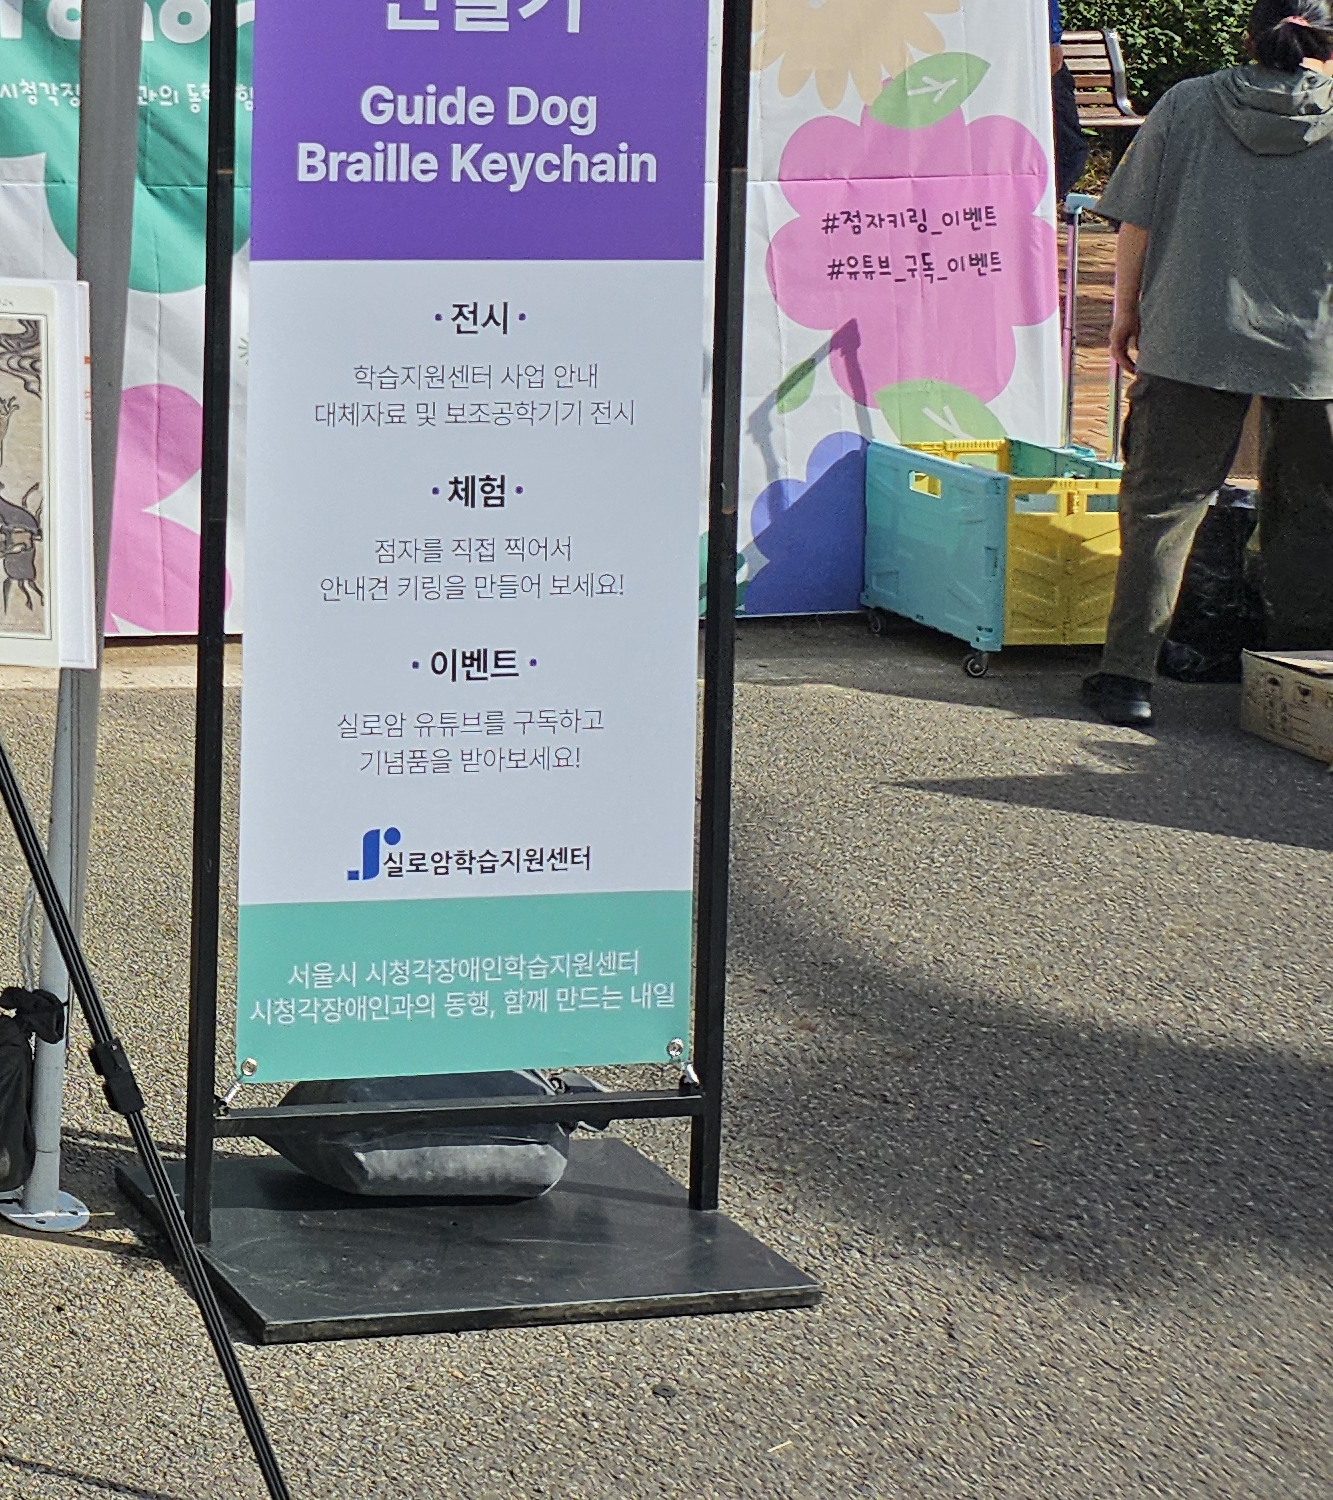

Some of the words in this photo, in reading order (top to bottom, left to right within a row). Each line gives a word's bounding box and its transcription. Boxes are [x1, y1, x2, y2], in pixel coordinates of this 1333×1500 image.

[361, 85, 495, 127] Guide
[507, 87, 598, 135] Dog
[297, 141, 438, 185] Braille
[451, 142, 658, 192] Keychain
[820, 204, 998, 235] #점자키링_이벤트
[826, 250, 1003, 284] #유튜브_구독_이벤트
[450, 301, 509, 335] 전시
[353, 364, 493, 390] 학습지원센터
[500, 364, 546, 389] 사업
[553, 363, 599, 389] 안내
[314, 402, 407, 427] 대체자료
[416, 402, 437, 427] 및
[445, 400, 583, 426] 보조공학기기
[590, 400, 636, 426] 전시
[448, 474, 506, 509] 체험
[374, 537, 444, 564] 점자를
[451, 537, 496, 563] 직접
[504, 536, 573, 562] 찍어서
[320, 575, 389, 602] 안내견
[397, 574, 467, 601] 키링을
[475, 573, 542, 599] 만들어
[550, 572, 625, 598] 보세요!
[431, 648, 519, 682] 이벤트
[337, 712, 406, 739] 실로암
[415, 710, 506, 738] 유튜브를
[513, 708, 604, 736] 구독하고
[360, 749, 451, 776] 기념품을
[460, 746, 581, 774] 받아보세요!
[383, 845, 592, 878] 실로암학습지원센터
[288, 962, 357, 990] 서울시
[366, 950, 640, 987] 시청각장애인학습지원센터
[250, 996, 436, 1025] 시청각장애인과의
[444, 989, 496, 1019] 동행,
[504, 987, 548, 1014] 함께
[556, 985, 623, 1012] 만드는
[631, 982, 676, 1009] 내일
